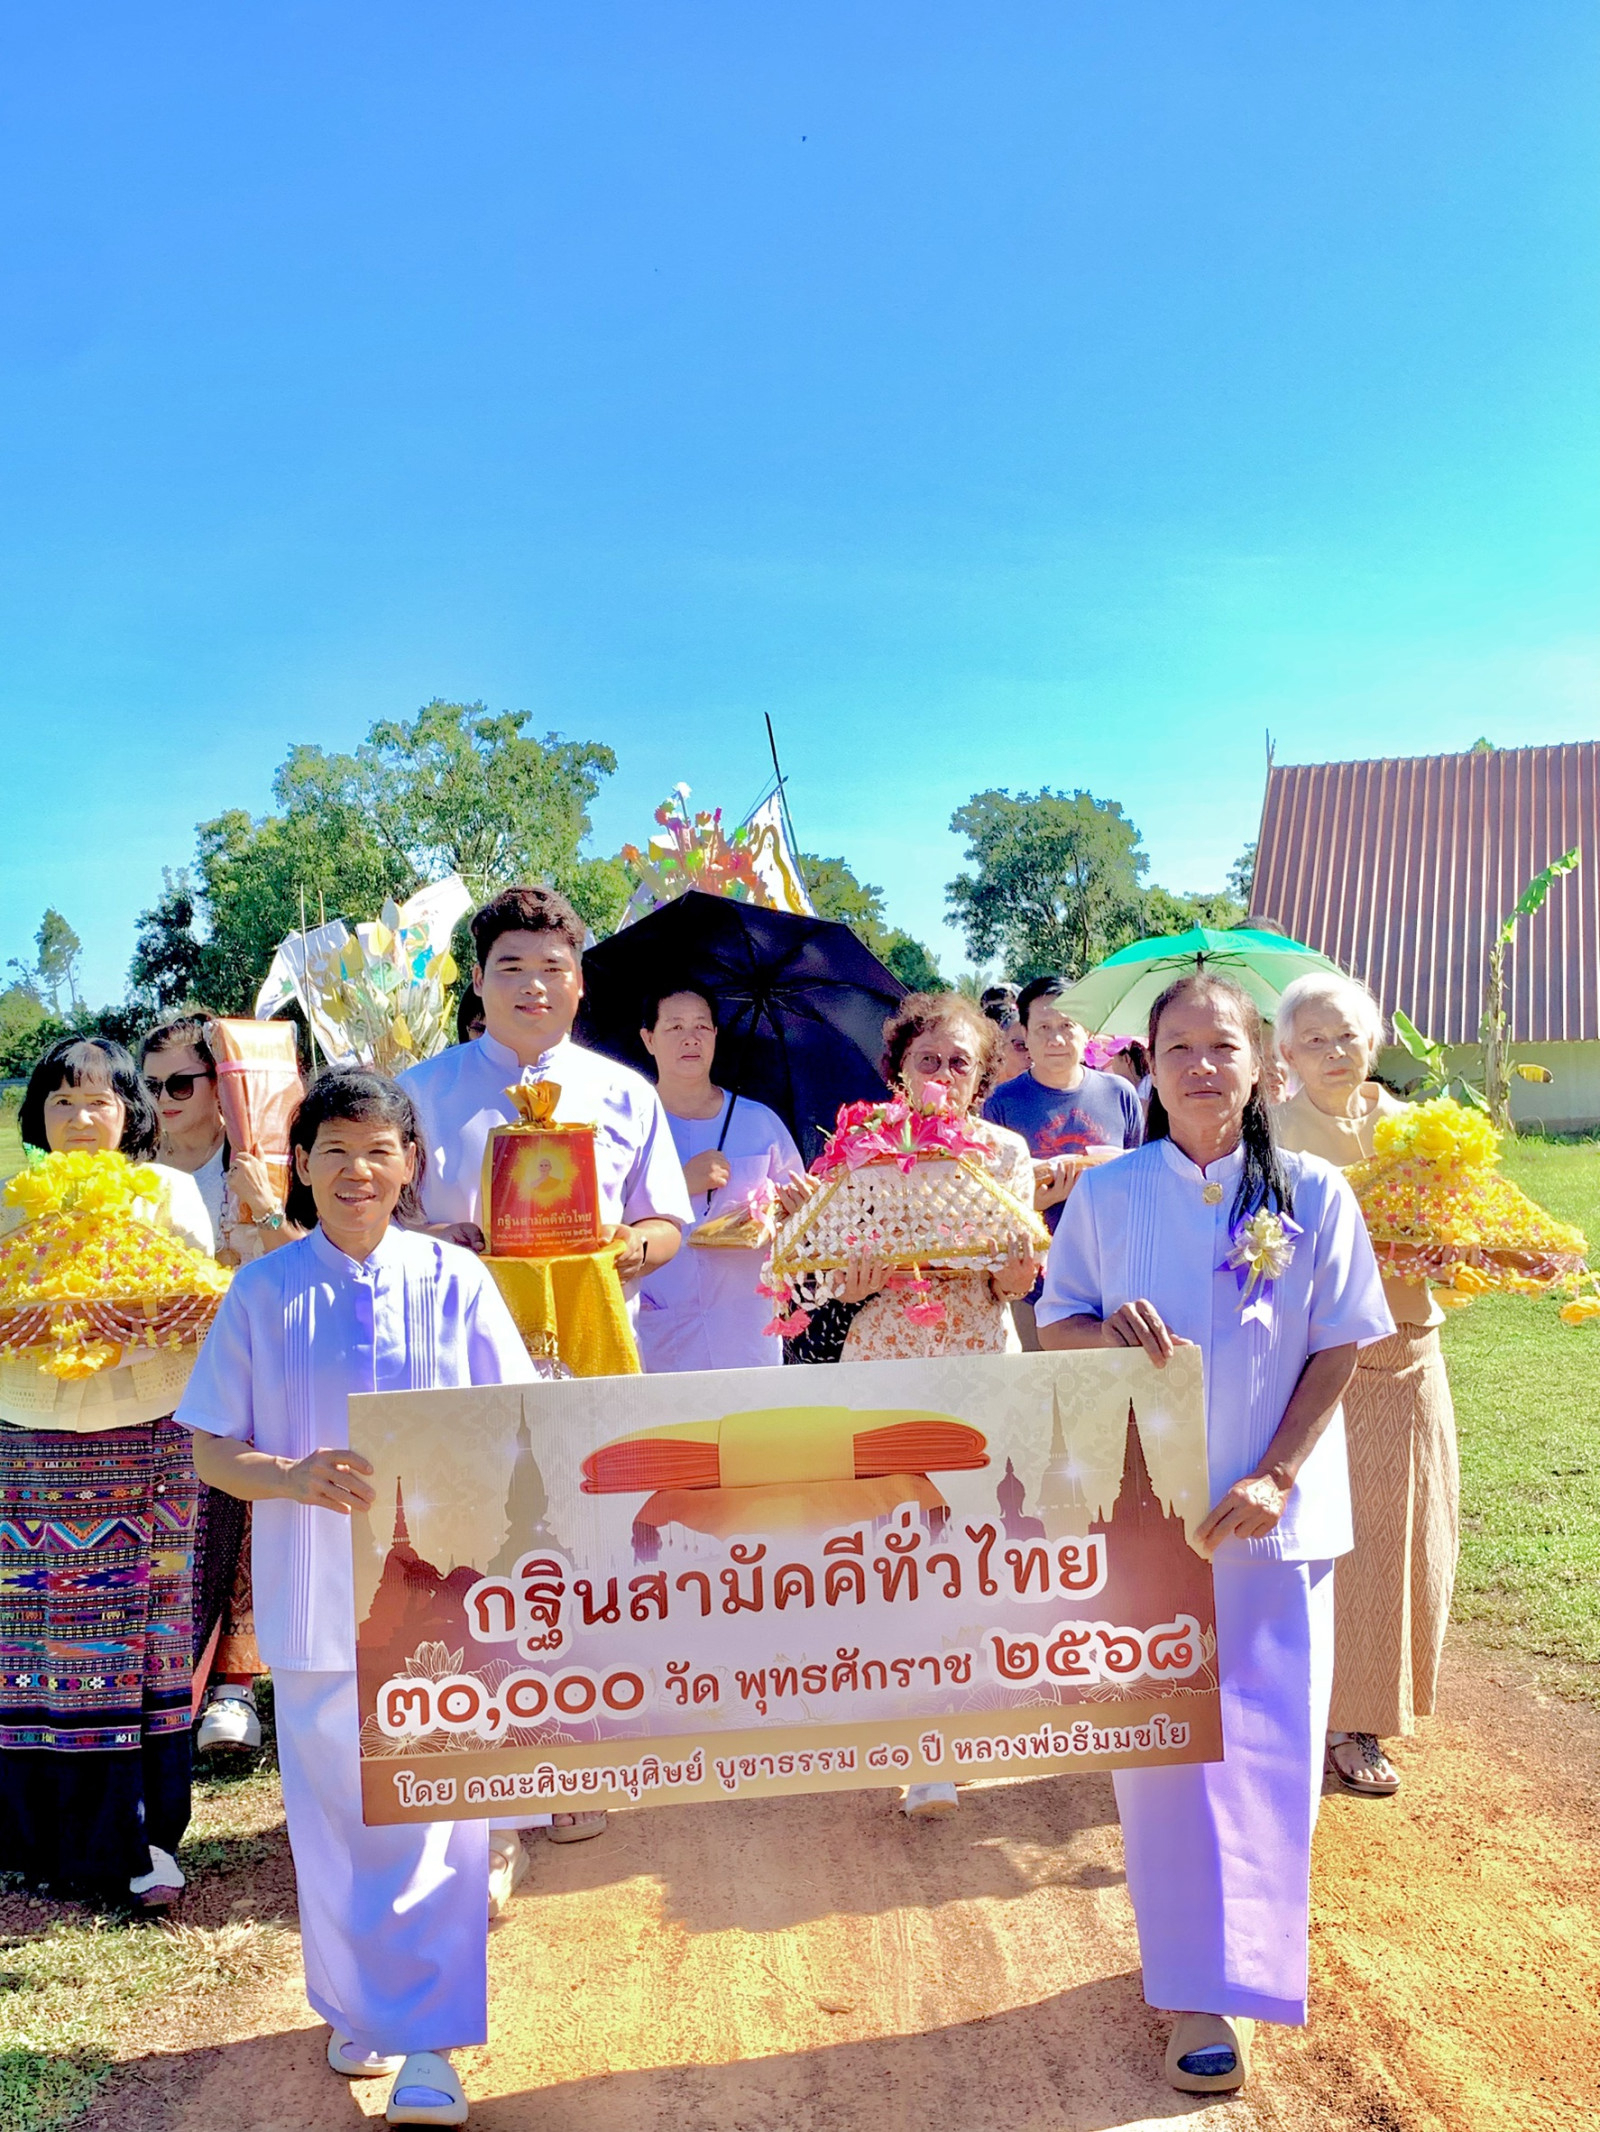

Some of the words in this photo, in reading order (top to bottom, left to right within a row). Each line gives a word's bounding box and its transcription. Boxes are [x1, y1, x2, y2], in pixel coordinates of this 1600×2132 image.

[473, 1510, 1100, 1652] กฐินสามัคคีทั่วไทย
[386, 1671, 645, 1731] ๓๐,๐๐๐
[664, 1660, 720, 1706] วัด
[735, 1646, 973, 1716] พุทธศักราช
[991, 1623, 1194, 1681] ๒๕๖๘
[396, 1775, 453, 1804] โดย
[467, 1749, 703, 1799] คณะศิษยานุศิษย์
[716, 1749, 855, 1789] บูชาธรรม
[869, 1745, 909, 1767] ๘๑
[922, 1733, 941, 1762] ปี
[954, 1718, 1186, 1760] หลวงพ่อธัมมชโย
